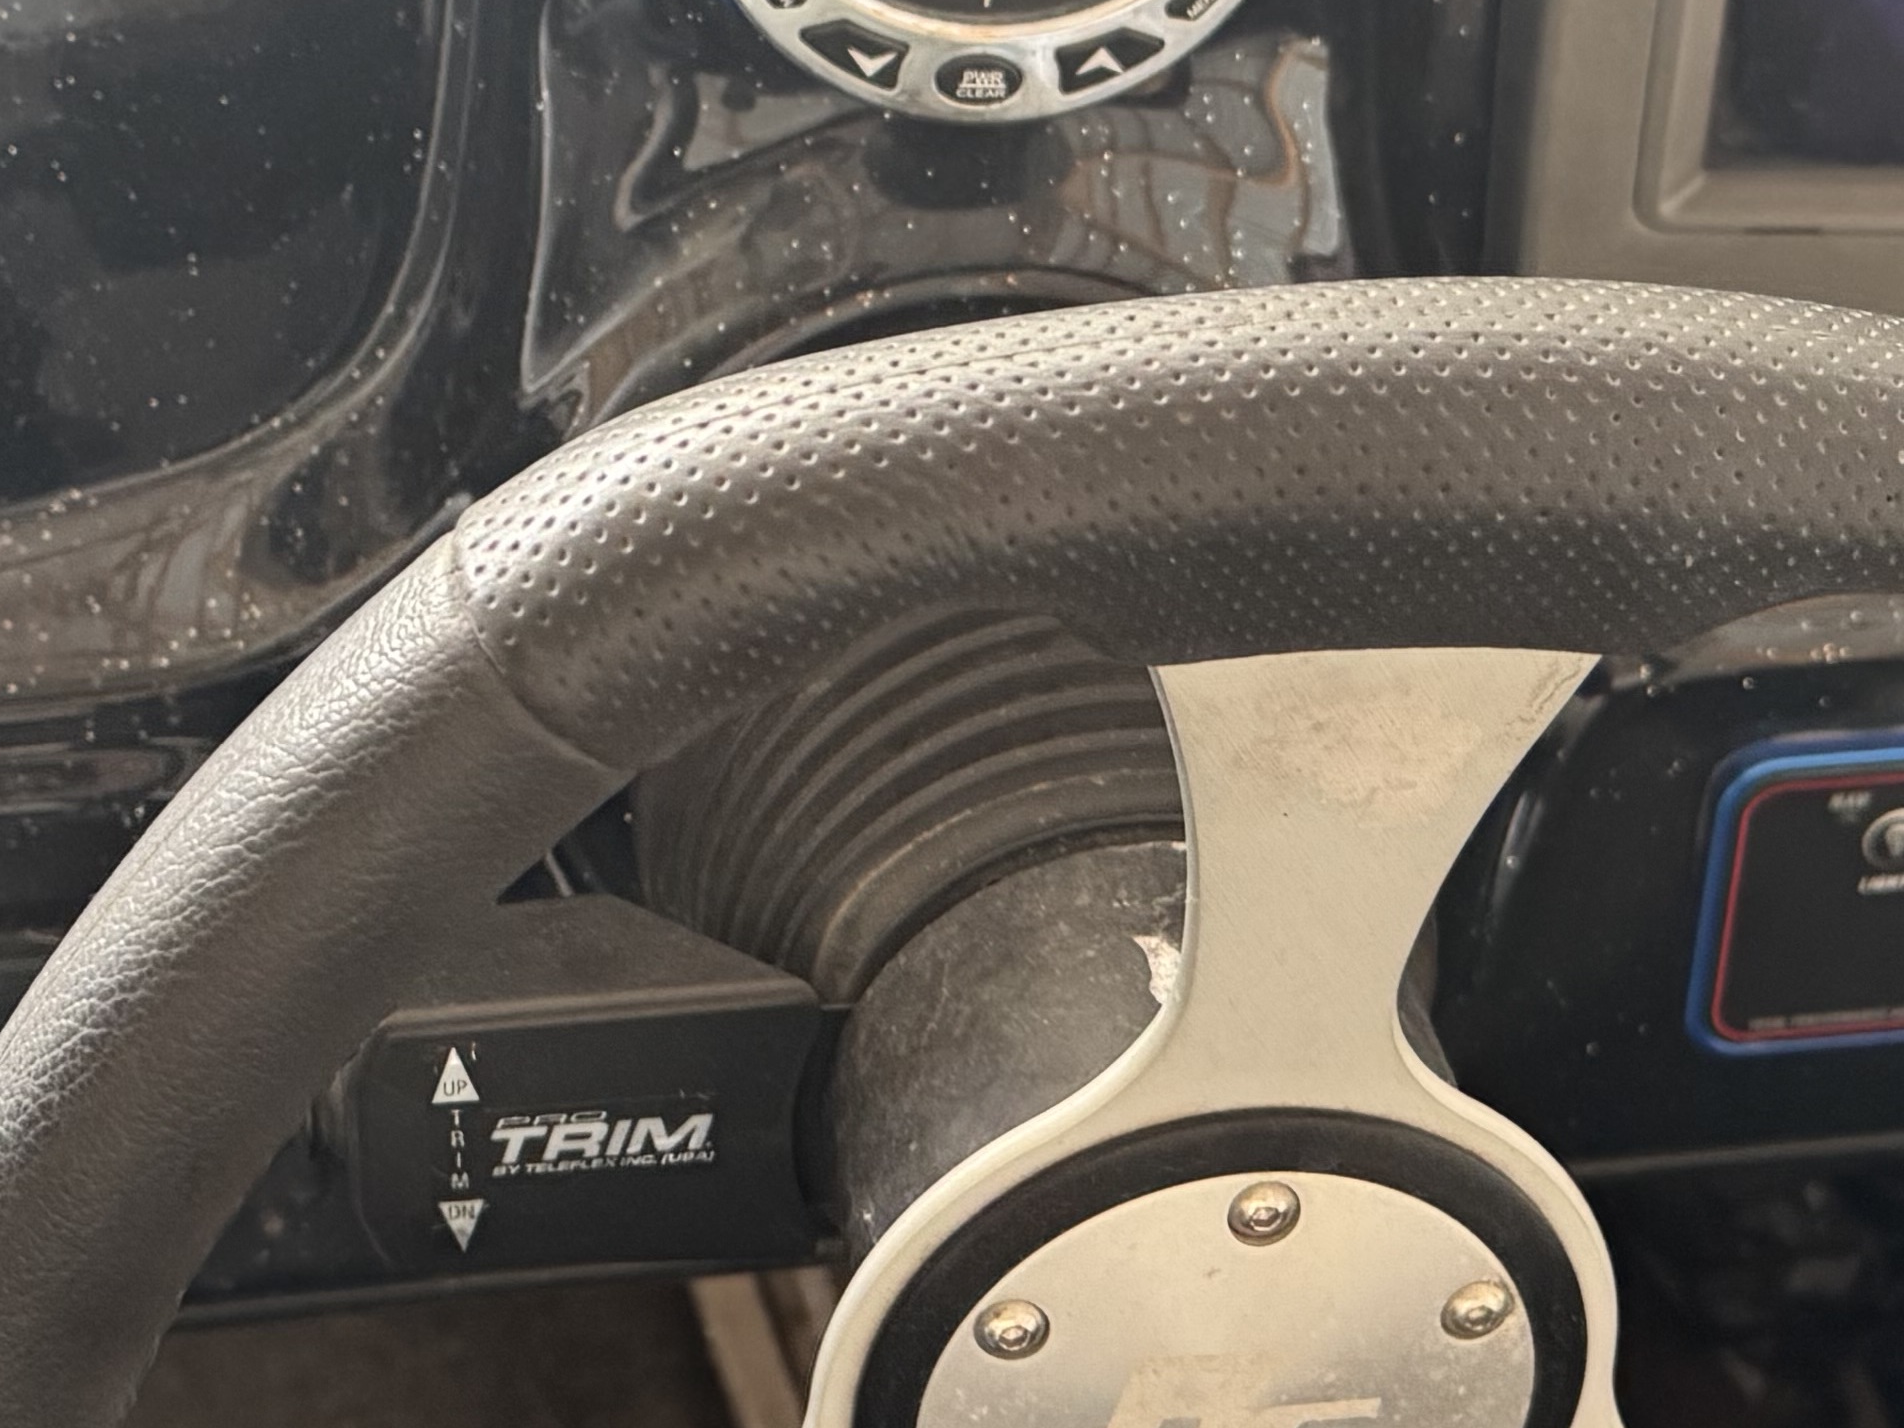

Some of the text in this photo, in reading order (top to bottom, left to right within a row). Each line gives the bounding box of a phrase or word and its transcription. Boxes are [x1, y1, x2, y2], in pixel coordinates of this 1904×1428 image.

[956, 88, 1007, 99] CLEAR
[443, 1079, 468, 1097] UP
[490, 1112, 714, 1165] TRIM
[492, 1164, 521, 1178] BY
[525, 1157, 618, 1174] TELEFLEX
[448, 1203, 476, 1220] DN
